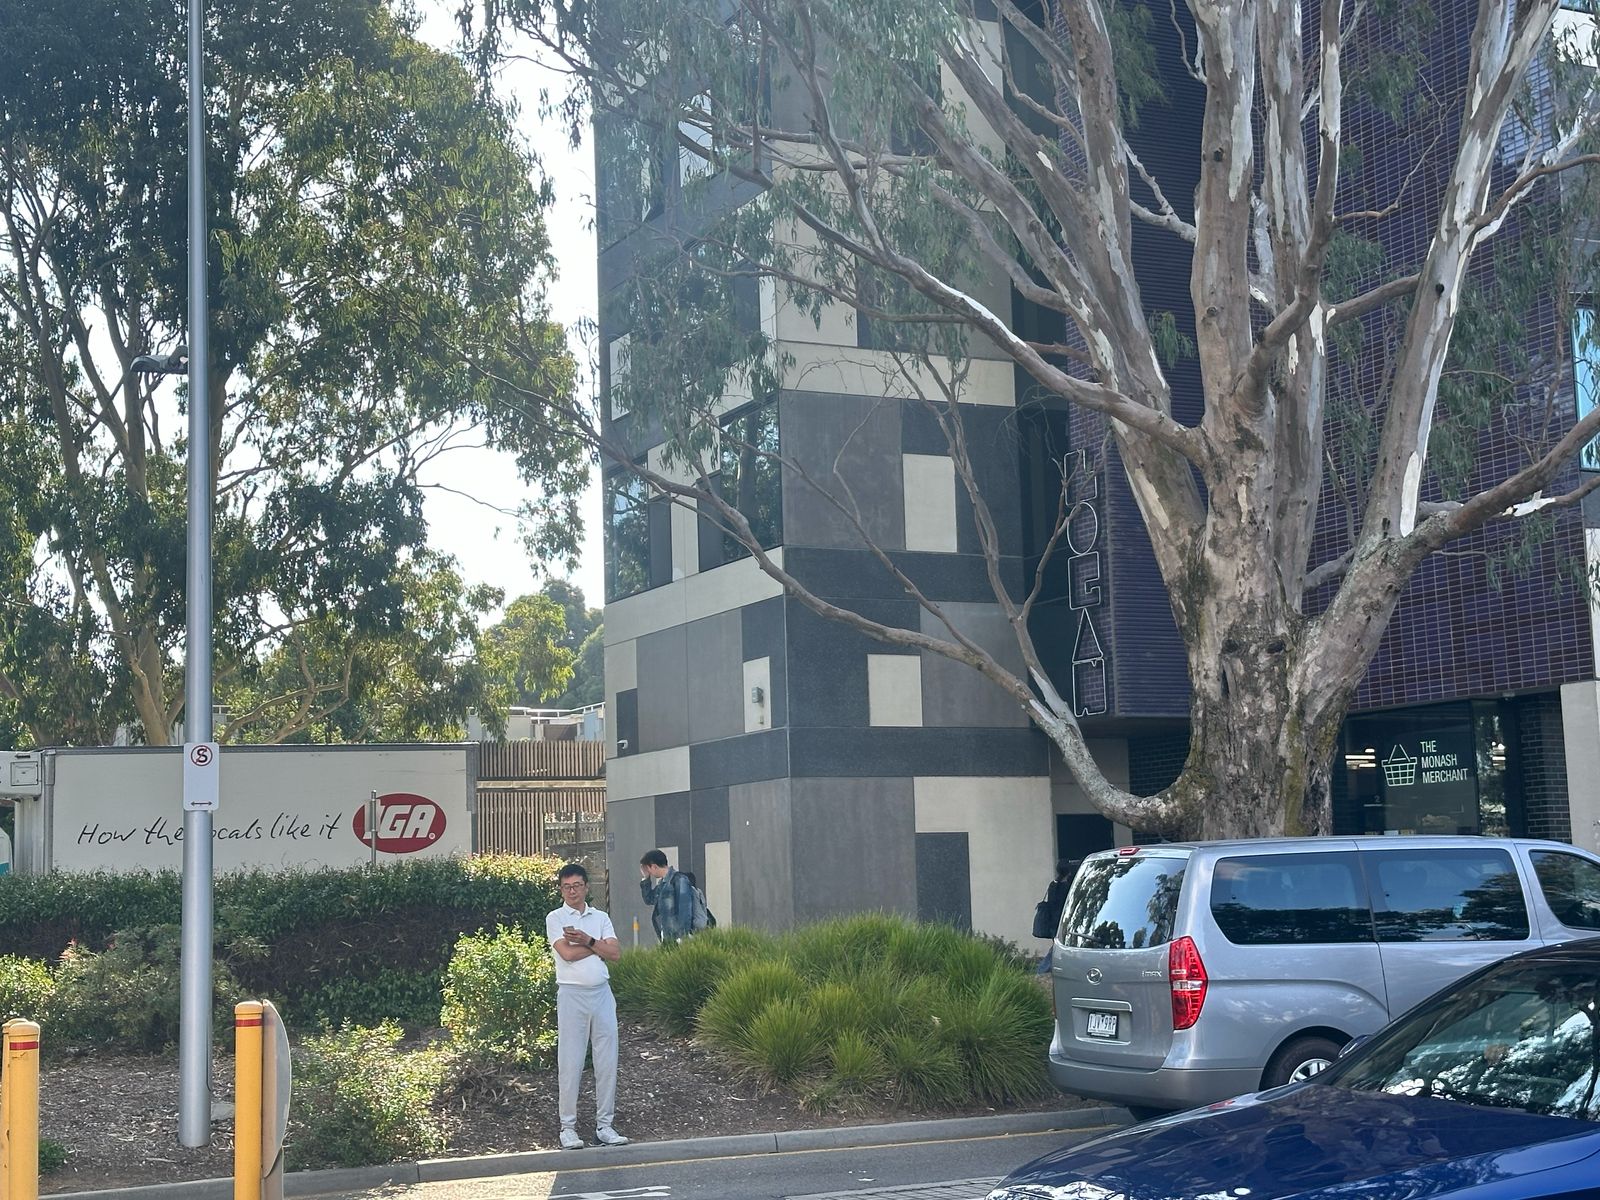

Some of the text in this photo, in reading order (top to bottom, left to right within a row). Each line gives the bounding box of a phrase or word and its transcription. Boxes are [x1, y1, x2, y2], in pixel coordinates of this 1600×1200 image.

[1063, 448, 1107, 718] LOGAN
[1420, 740, 1437, 753] THE
[1421, 753, 1458, 769] MONASH
[1422, 768, 1469, 784] MERCHANT
[77, 811, 343, 845] How the ocals like it
